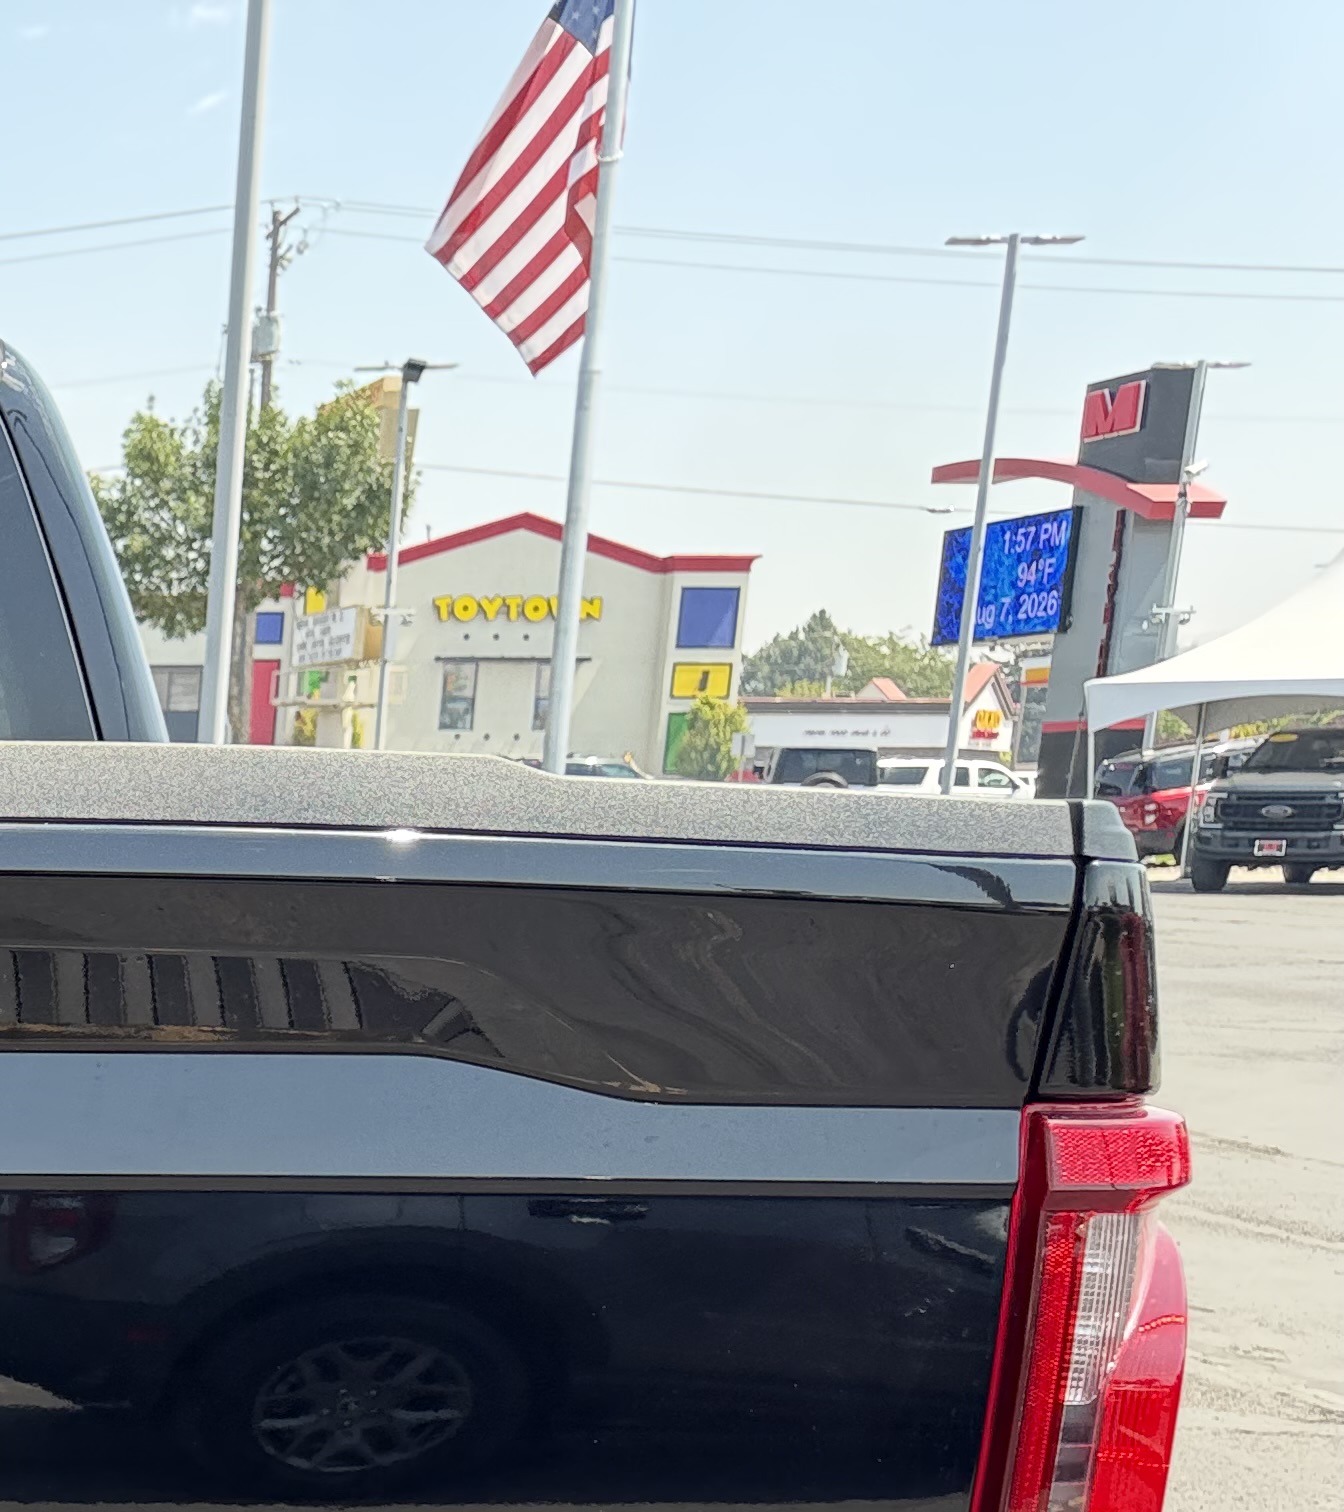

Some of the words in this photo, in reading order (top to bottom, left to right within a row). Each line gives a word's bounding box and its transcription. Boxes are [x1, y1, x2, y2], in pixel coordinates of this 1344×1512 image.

[1083, 379, 1146, 442] M
[1003, 525, 1037, 555] 1:57
[1039, 519, 1068, 549] PM
[1017, 557, 1057, 588] 94°F
[974, 603, 996, 630] ug
[1017, 589, 1060, 620] 2026
